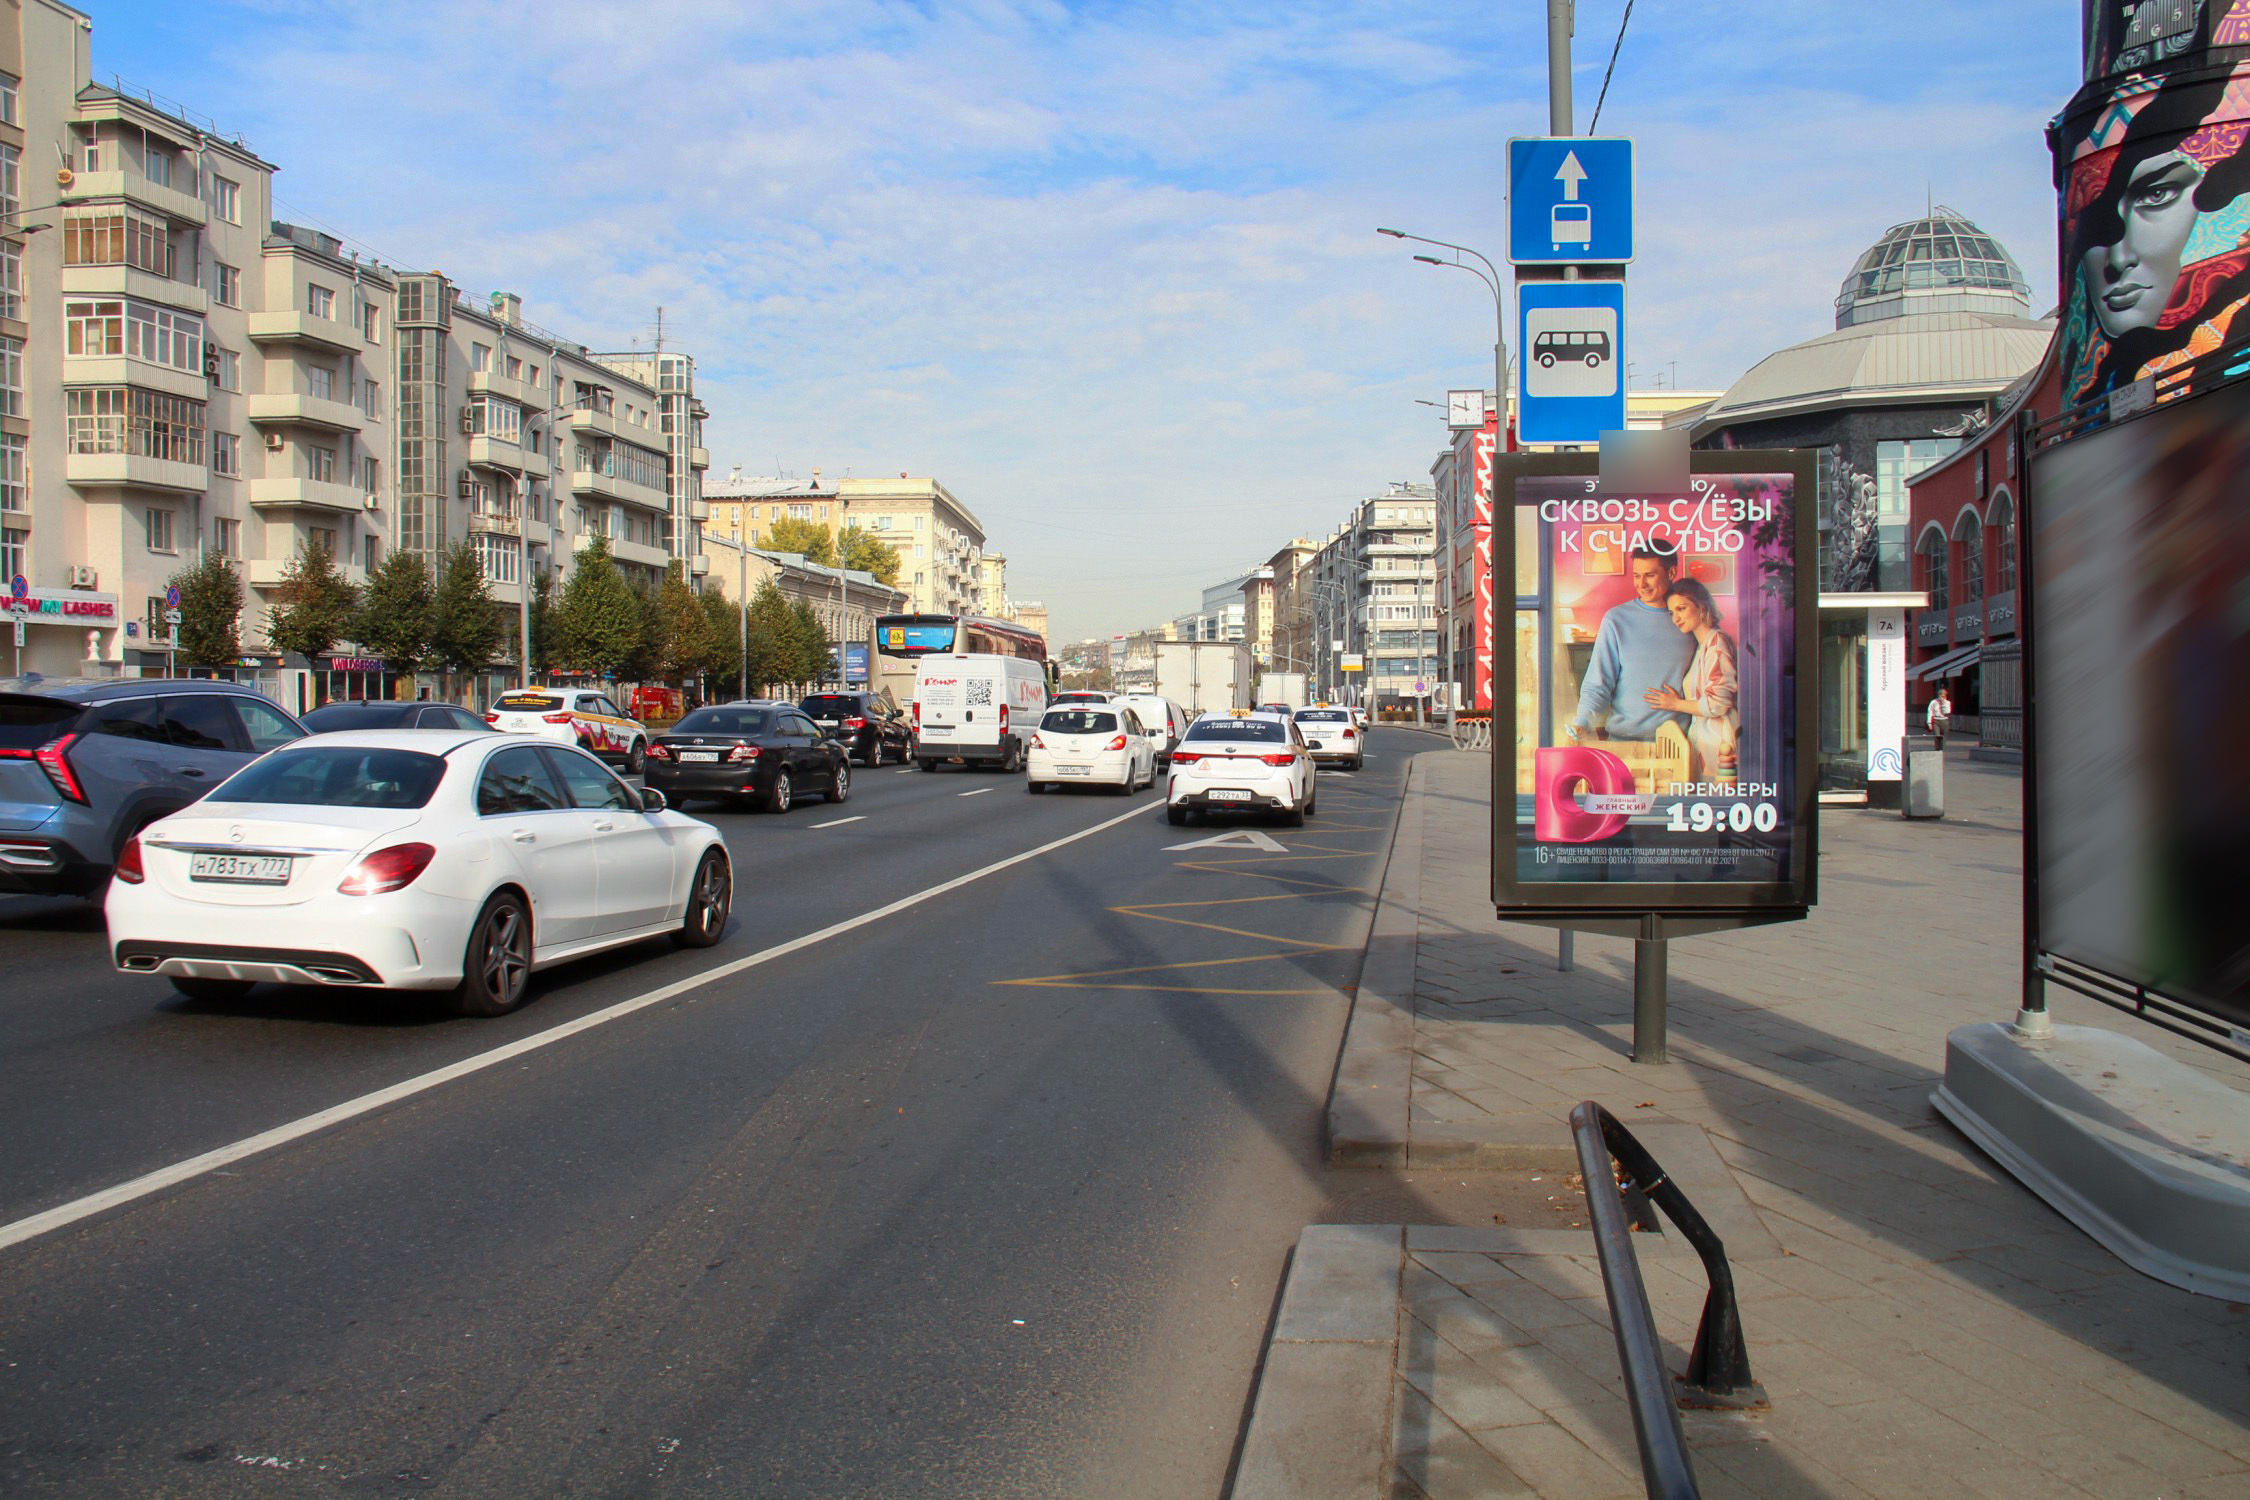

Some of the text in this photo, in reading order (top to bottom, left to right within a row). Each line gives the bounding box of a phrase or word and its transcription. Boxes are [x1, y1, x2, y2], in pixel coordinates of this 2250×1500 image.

[1540, 484, 1772, 533] СКВОЗЬ СЛЁЗЫ
[1561, 522, 1744, 556] К СЧАСТЬЮ
[64, 601, 113, 617] LASHES
[1669, 782, 1778, 797] ПРЕМЬЕРЫ
[1595, 802, 1647, 811] ЖЕНСКИЙ
[1666, 802, 1778, 833] 19:00
[1534, 845, 1555, 864] 16+
[1556, 848, 1607, 856] СВИДЕТЕЛЬСТВО
[1613, 848, 1656, 856] РЕГИСТРАЦИИ
[1656, 848, 1670, 856] СМИ
[1691, 848, 1700, 856] ФС
[1732, 848, 1740, 856] ОТ
[1695, 856, 1703, 864] ОТ
[197, 857, 286, 875] Н783ТХ 777
